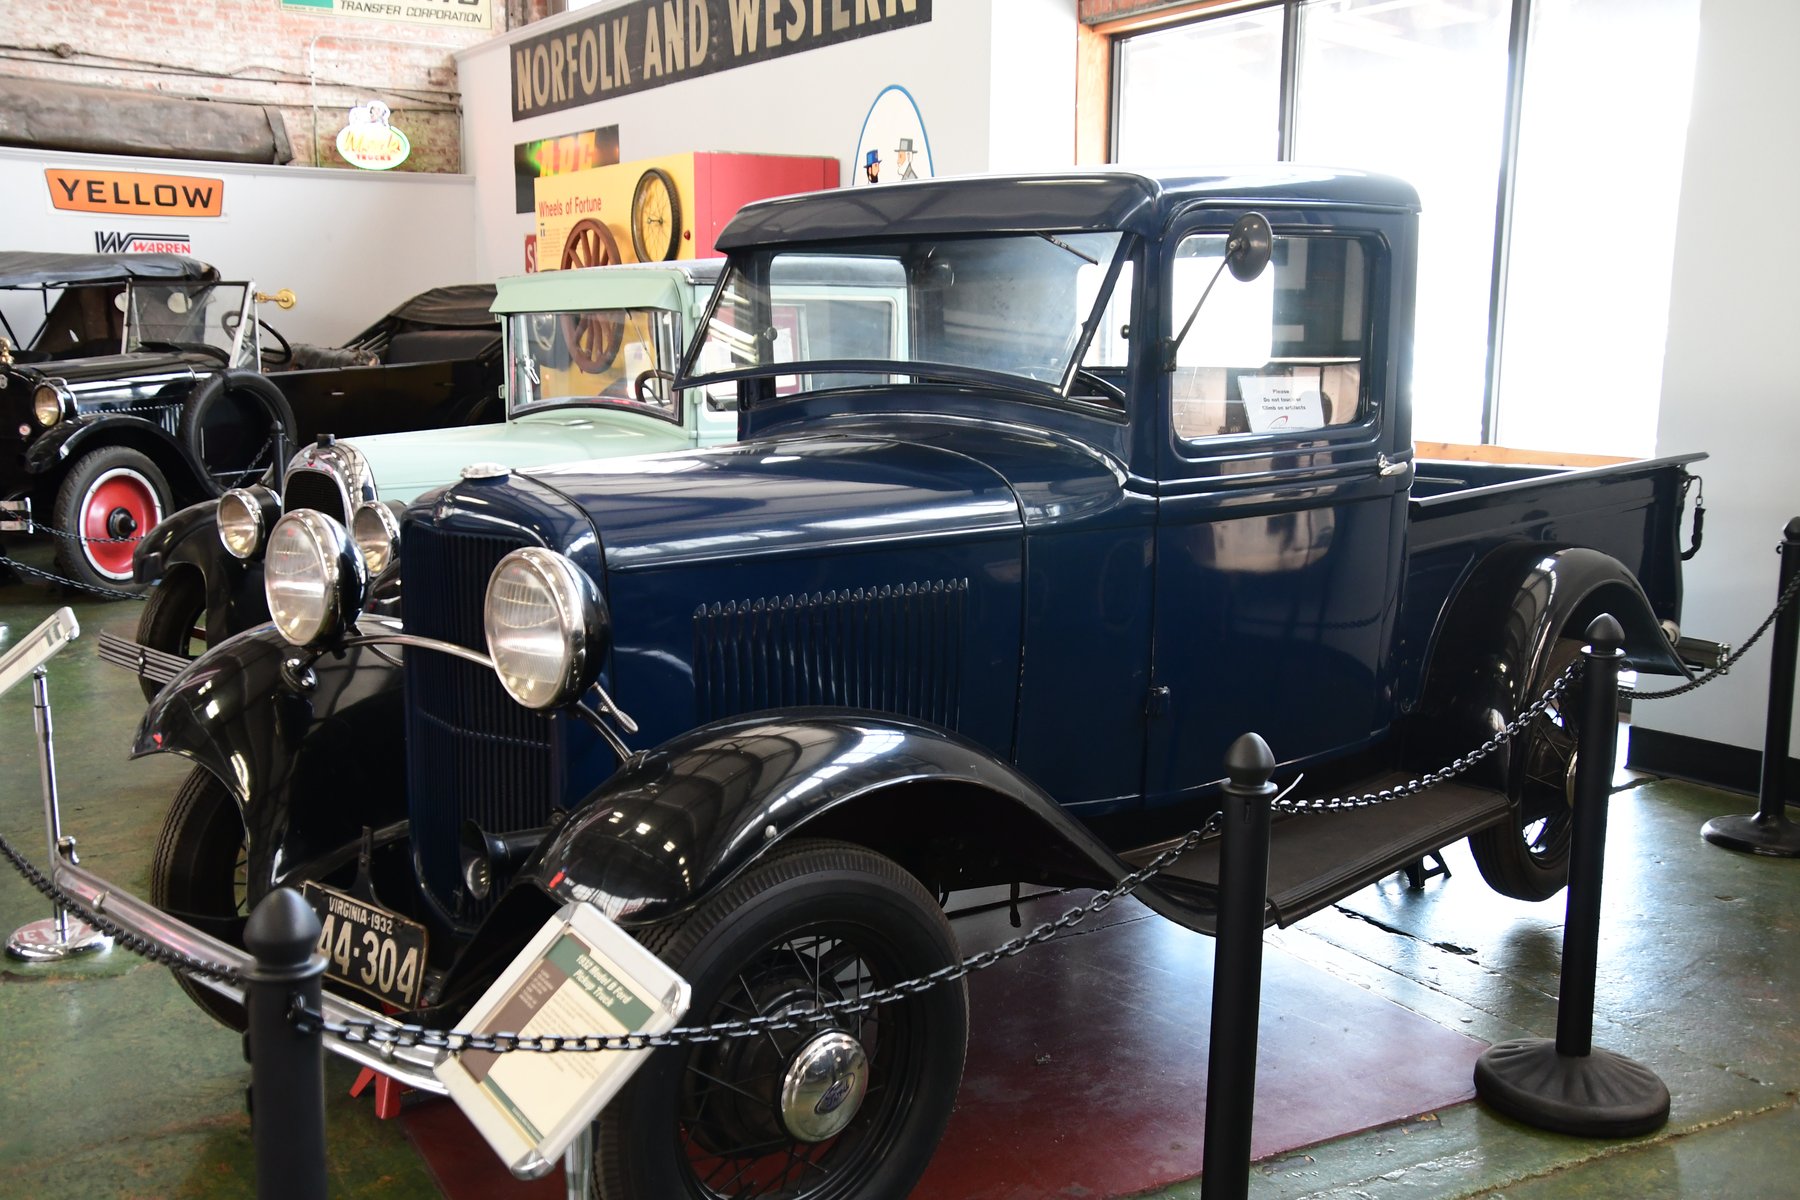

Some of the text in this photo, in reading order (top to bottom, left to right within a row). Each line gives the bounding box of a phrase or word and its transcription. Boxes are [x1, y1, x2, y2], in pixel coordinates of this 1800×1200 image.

[340, 0, 401, 16] TRANSFER
[406, 7, 482, 23] CORPORATION
[516, 15, 632, 112] NORFOLK
[643, 0, 709, 80] AND
[58, 178, 213, 208] YELLOW
[539, 196, 602, 217] Wheels of Fortune
[133, 241, 191, 254] WARREN
[572, 967, 597, 992] Pickup
[592, 985, 614, 1008] Truck
[575, 953, 594, 971] 1932
[588, 965, 612, 987] Model
[612, 985, 633, 1005] Ford
